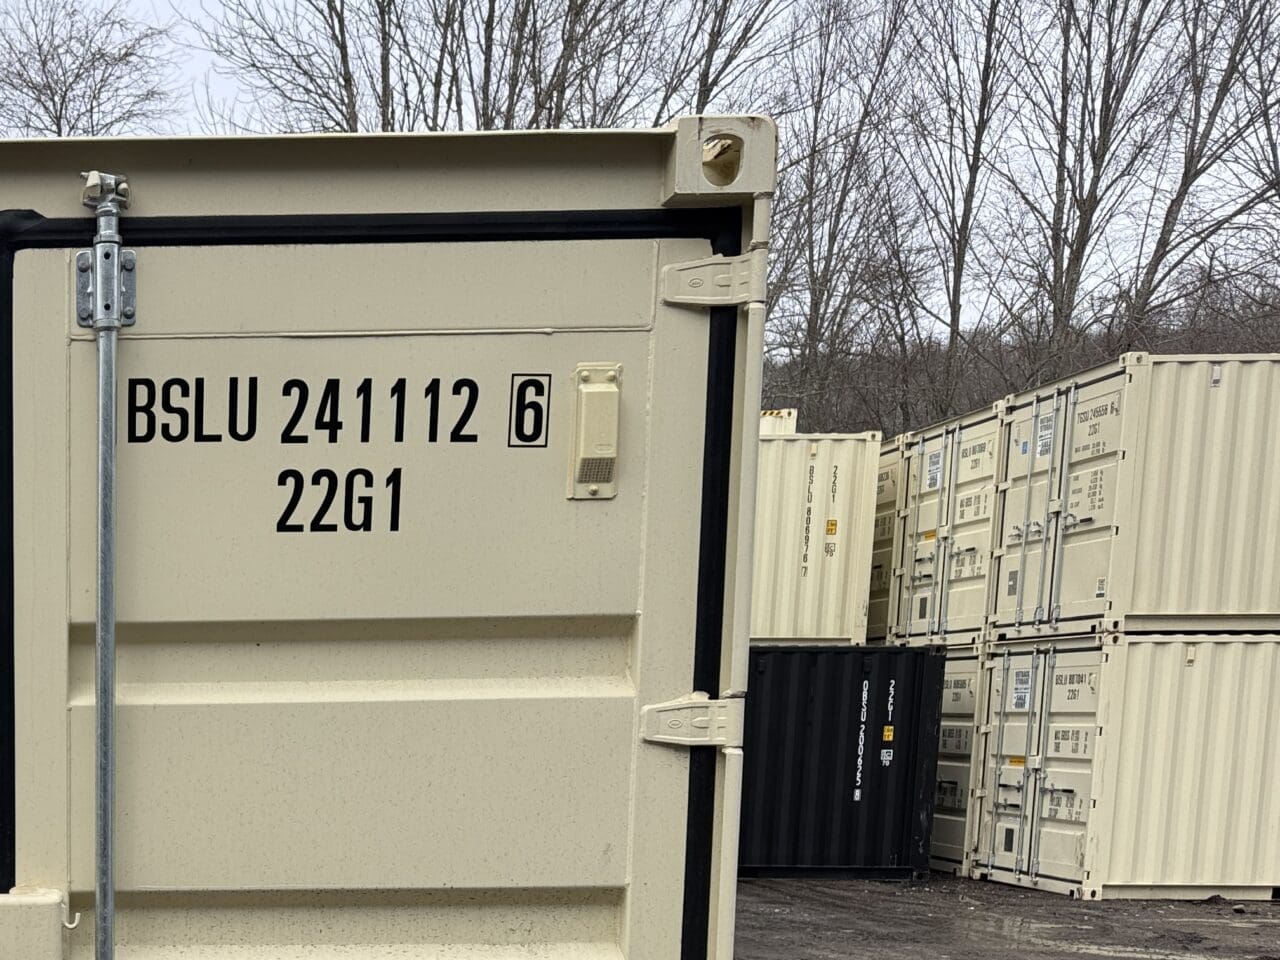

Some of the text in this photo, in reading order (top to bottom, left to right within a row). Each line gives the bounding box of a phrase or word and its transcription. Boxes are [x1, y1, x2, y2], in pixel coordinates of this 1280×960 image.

[127, 376, 546, 444] BSLU 241112 6
[276, 467, 403, 534] 22G1
[856, 724, 865, 786] 200625
